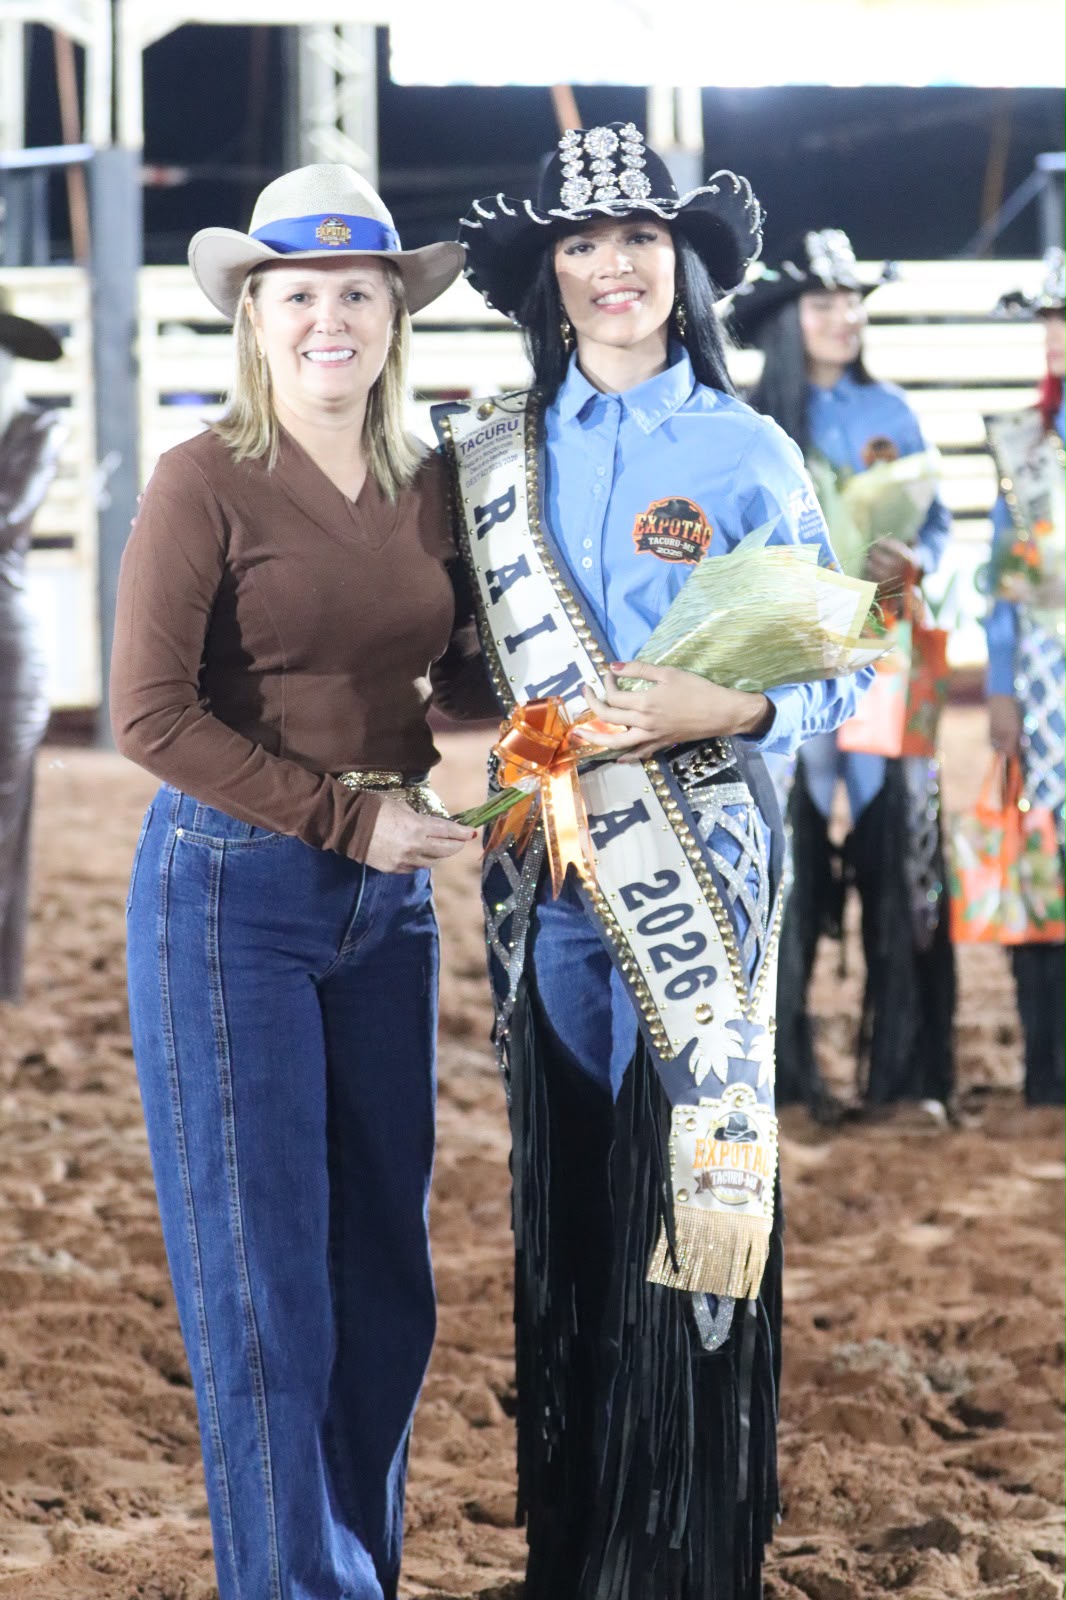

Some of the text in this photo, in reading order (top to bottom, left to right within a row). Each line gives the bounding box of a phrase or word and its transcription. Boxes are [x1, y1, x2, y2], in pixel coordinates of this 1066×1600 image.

[459, 419, 519, 456] TACURU
[635, 513, 713, 549] EXPOTAC
[647, 536, 696, 554] TACURU-MS
[618, 869, 718, 1001] 2026
[693, 1138, 771, 1177] EXPOTAC
